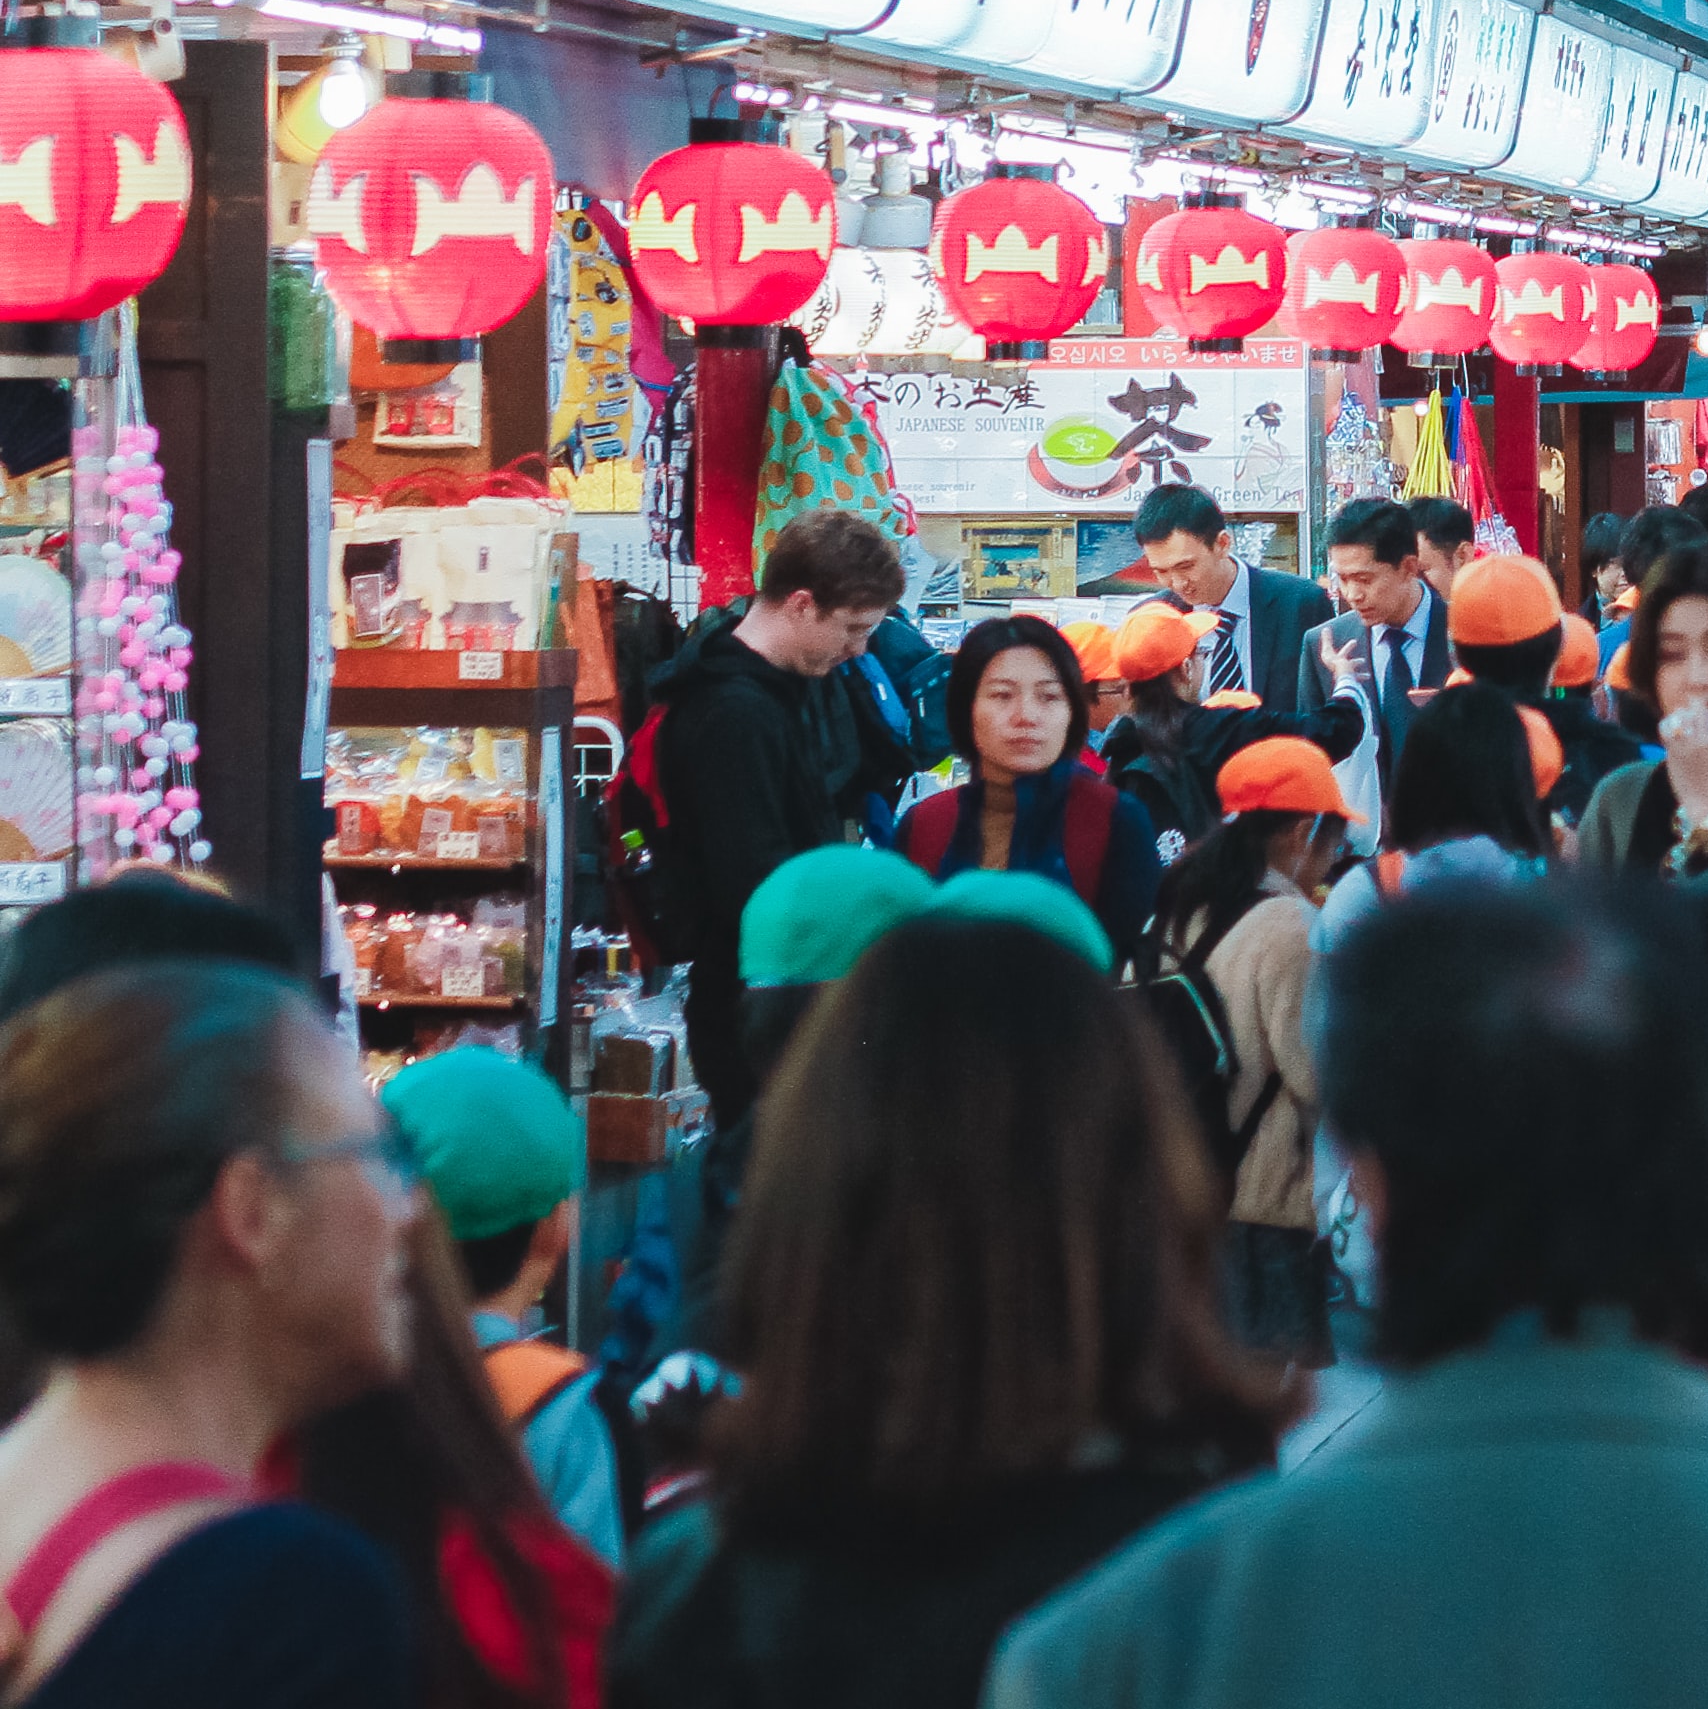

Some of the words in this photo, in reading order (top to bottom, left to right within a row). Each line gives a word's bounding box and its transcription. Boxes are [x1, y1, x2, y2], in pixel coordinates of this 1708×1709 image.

[896, 417, 966, 432] JAPANESE
[975, 417, 1045, 432] SOUVENIR
[1107, 372, 1213, 485] 茶
[914, 494, 935, 503] best
[1213, 486, 1260, 502] Green
[1274, 487, 1301, 502] Tea
